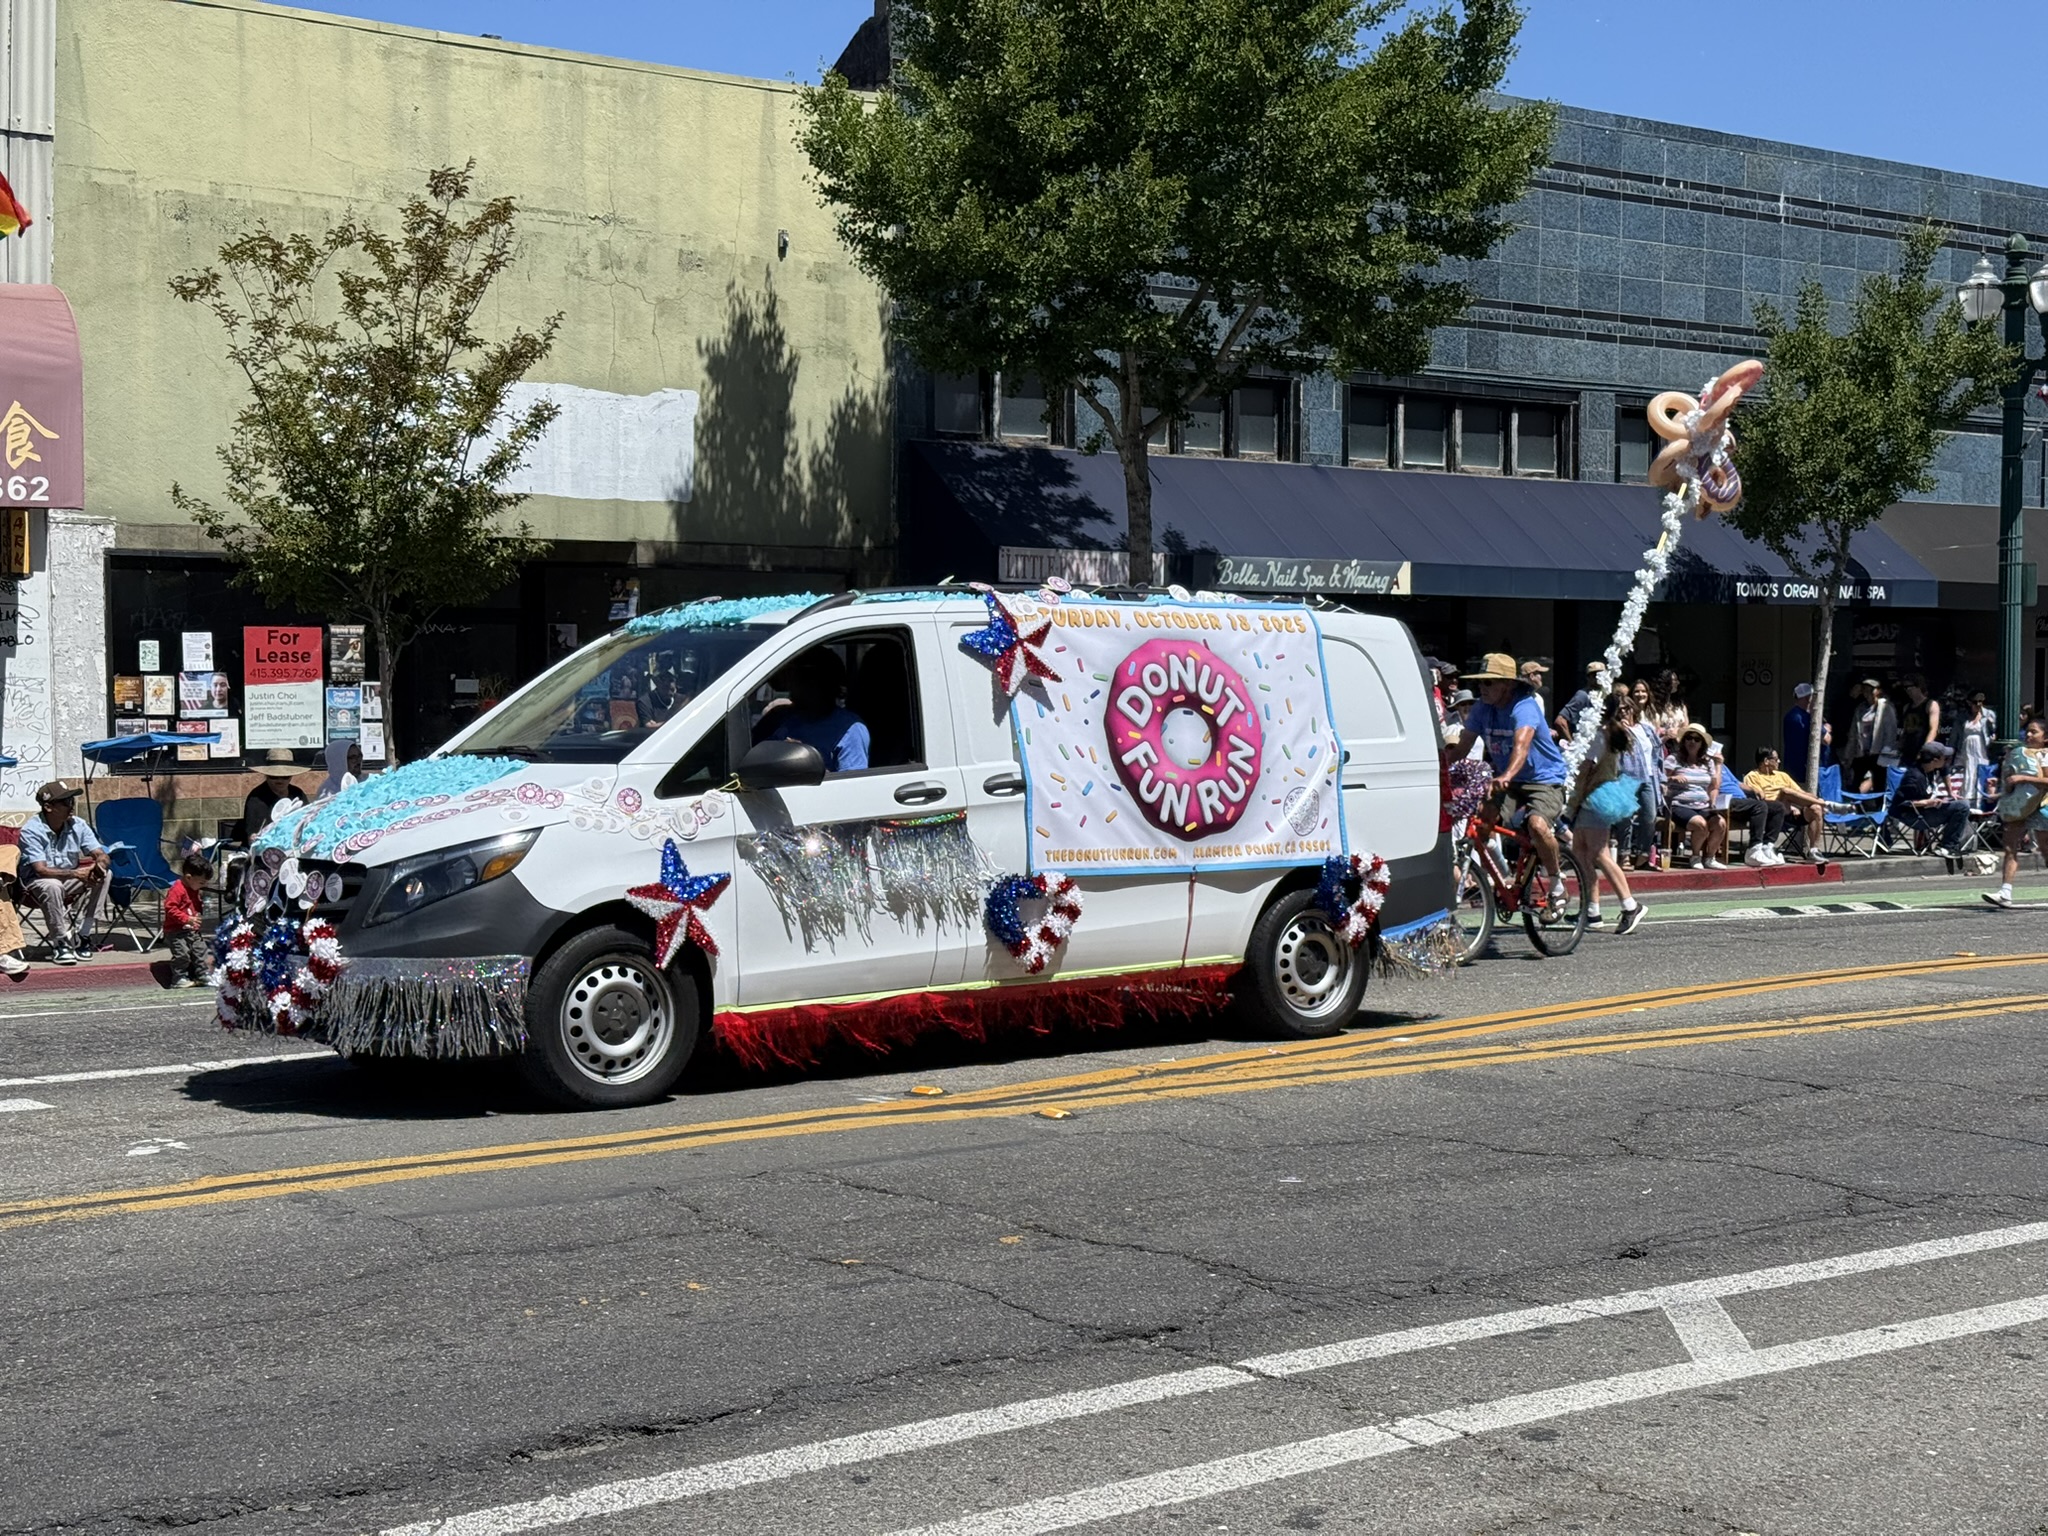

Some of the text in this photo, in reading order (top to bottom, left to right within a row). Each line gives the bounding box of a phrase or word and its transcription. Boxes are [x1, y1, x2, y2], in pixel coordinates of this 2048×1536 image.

[0, 400, 60, 470] 食
[0, 475, 50, 501] 62
[1217, 558, 1391, 594] Bella Nail Spa & Waxing
[1736, 582, 1886, 600] TOMO'S ORGA NAIL SPA
[1014, 607, 1307, 635] TURDAY, OCTOBER 18, 2025
[267, 629, 300, 645] For
[255, 647, 311, 663] Lease
[249, 668, 319, 679] 415.395.7262
[248, 691, 297, 700] Justin Choi
[1116, 654, 1246, 728] DONUT
[248, 713, 265, 721] Jeff
[1121, 734, 1256, 827] FUN RUN
[1045, 846, 1178, 863] THEDONUTFUNRUN.COM
[1193, 843, 1243, 859] ALAMEDA
[1284, 840, 1297, 854] CA
[1298, 839, 1331, 853] 94501
